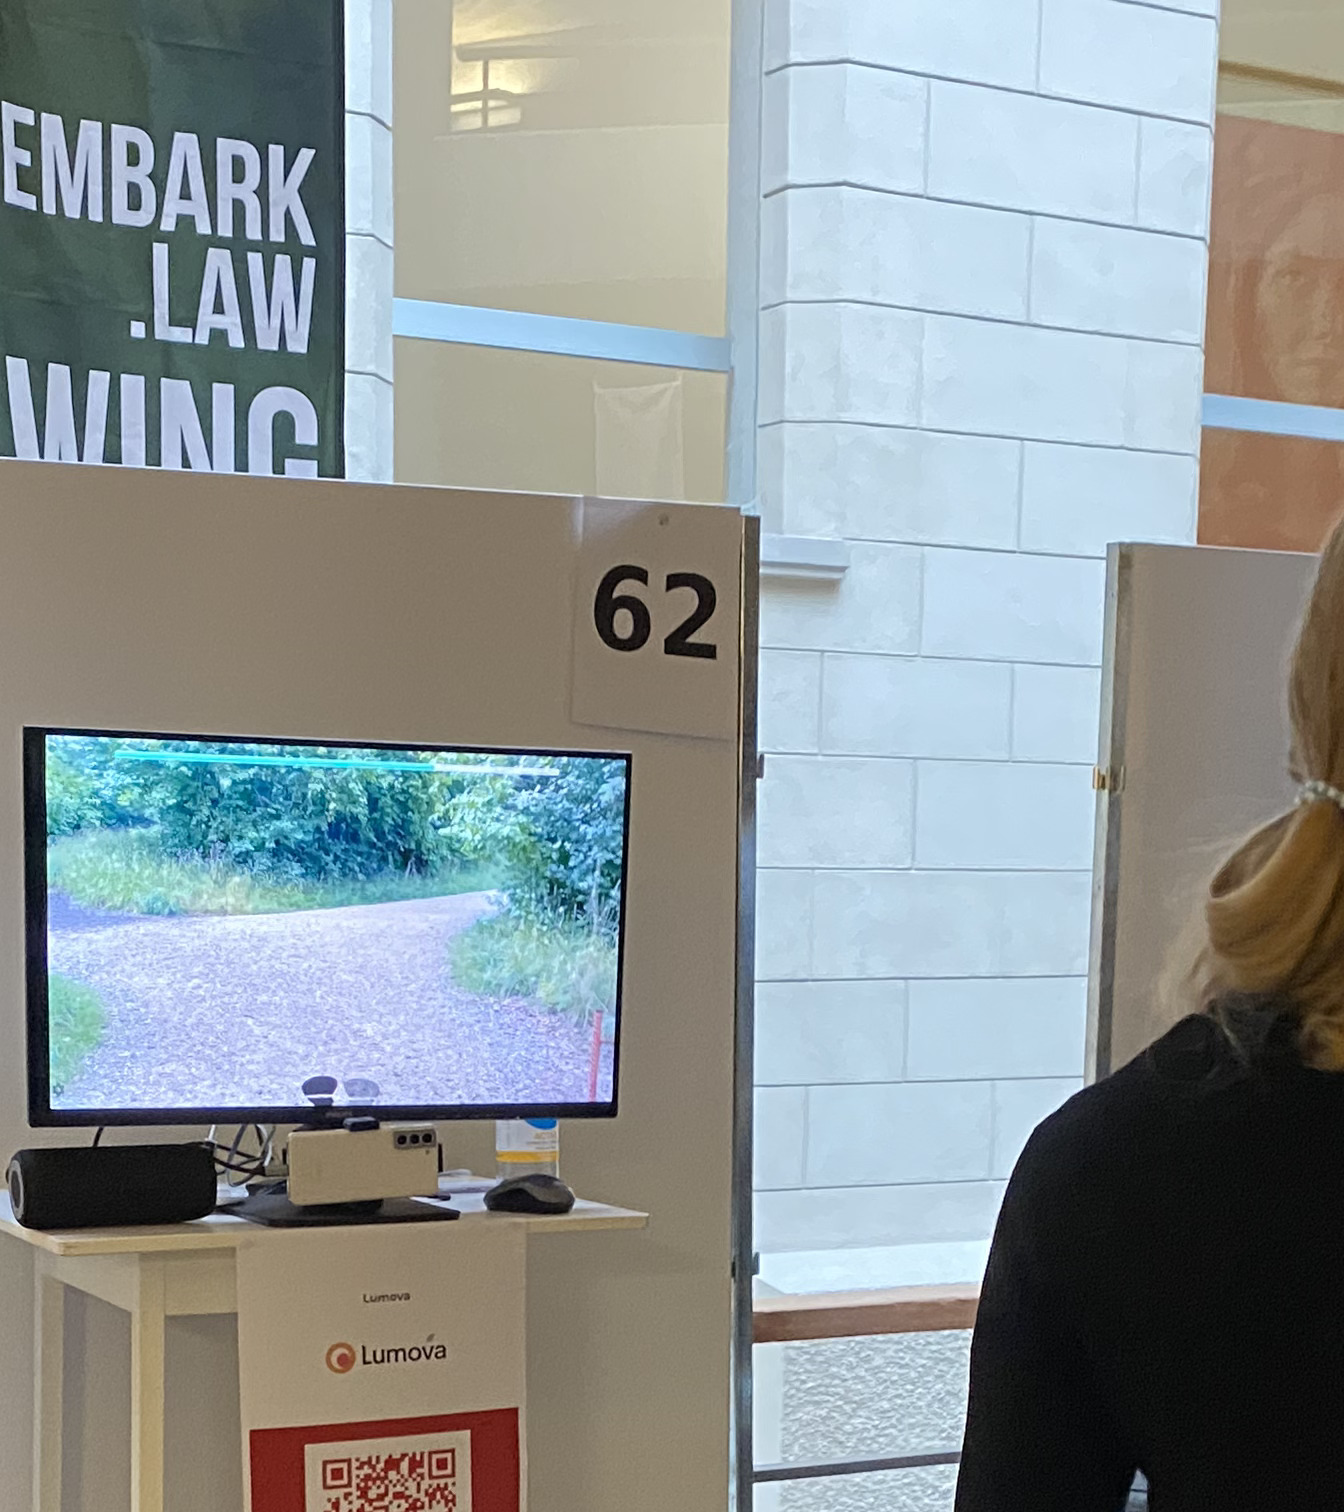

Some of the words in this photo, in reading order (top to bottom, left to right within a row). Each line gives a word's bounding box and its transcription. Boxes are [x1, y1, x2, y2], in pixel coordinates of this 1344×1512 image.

[0, 100, 318, 248] EMBARK
[129, 242, 317, 355] .LAW
[592, 563, 719, 660] 62
[362, 1290, 411, 1304] Lumova
[361, 1341, 447, 1366] Lumova
